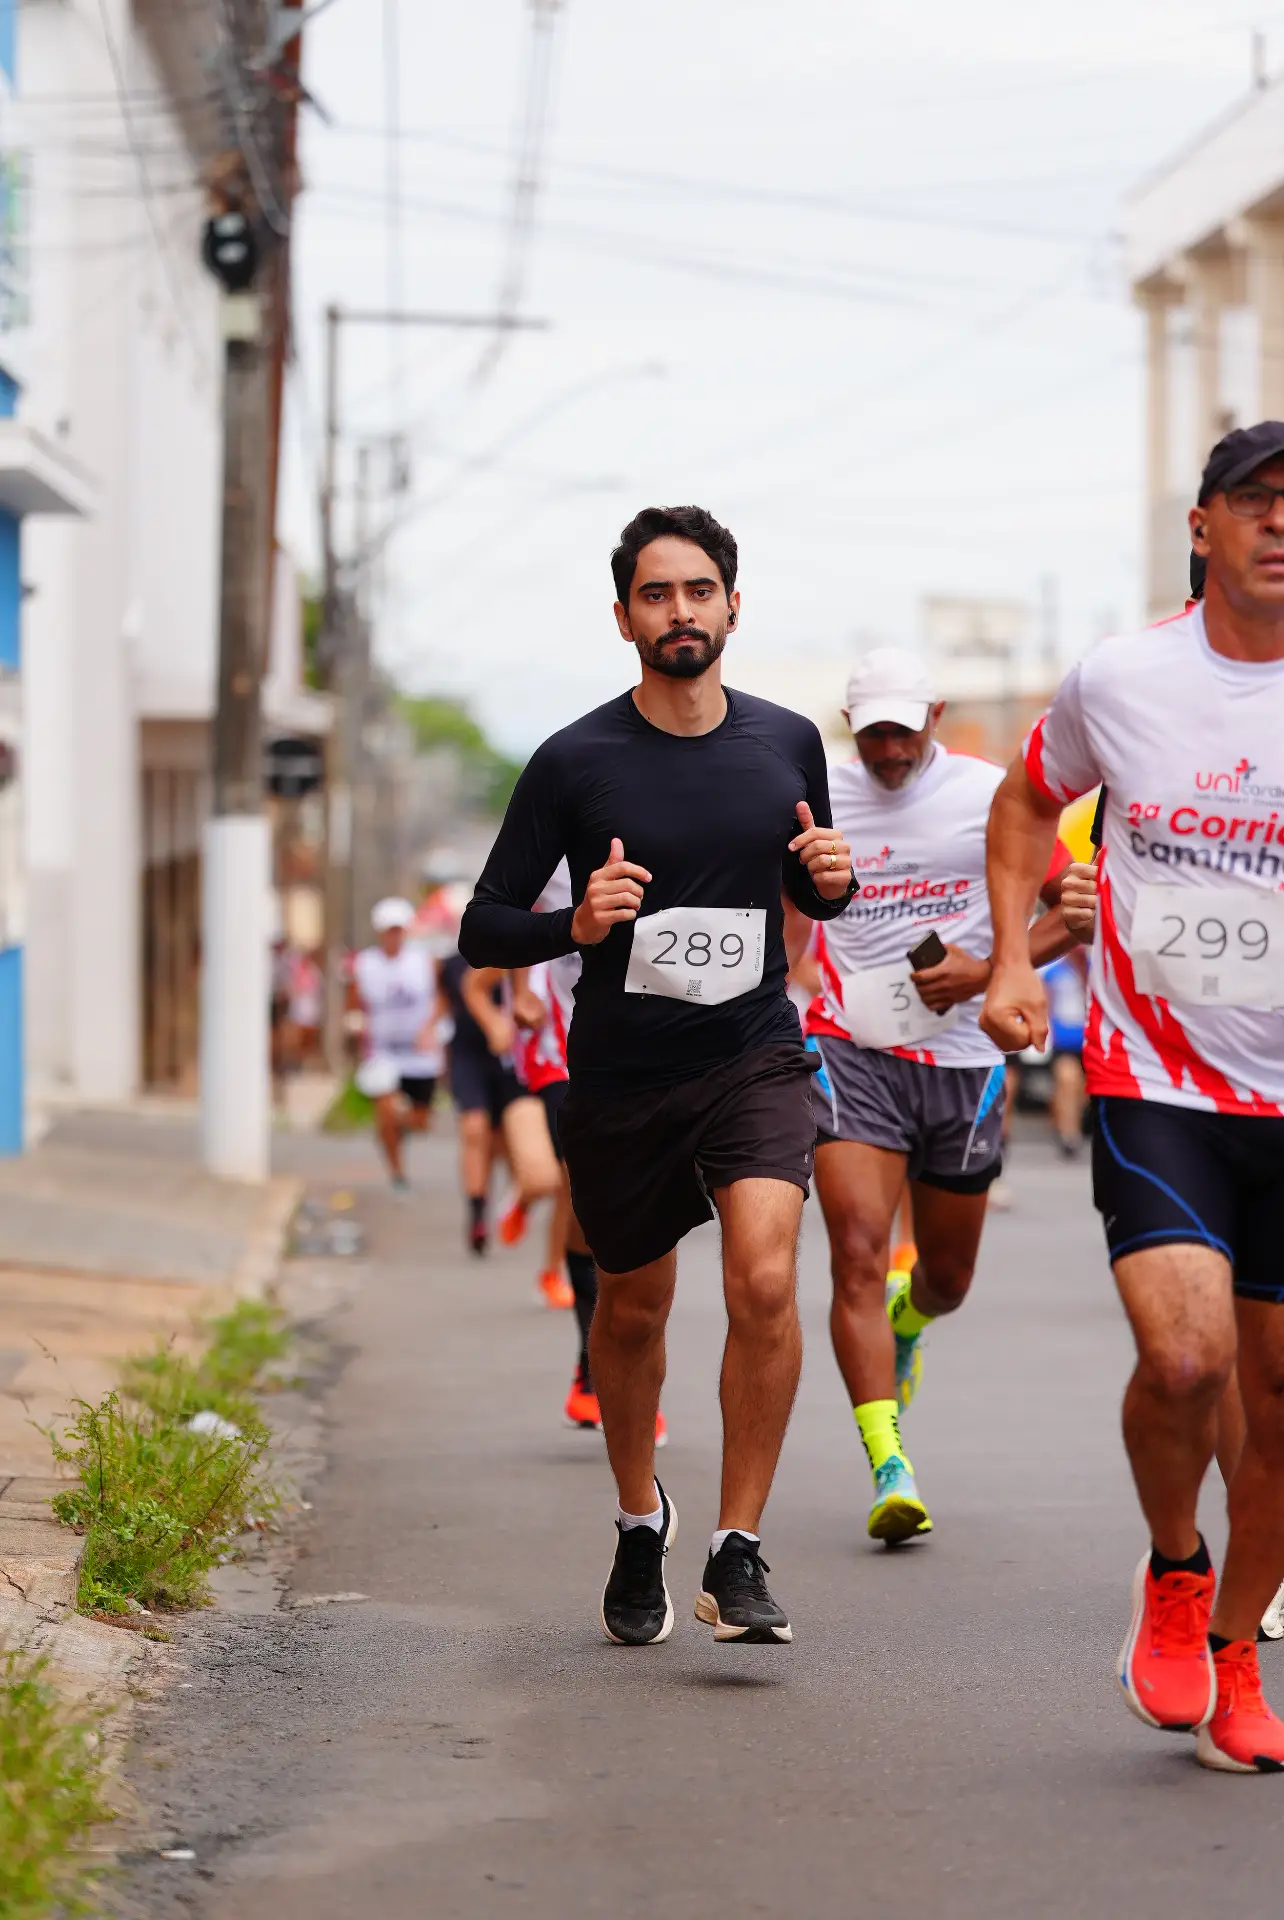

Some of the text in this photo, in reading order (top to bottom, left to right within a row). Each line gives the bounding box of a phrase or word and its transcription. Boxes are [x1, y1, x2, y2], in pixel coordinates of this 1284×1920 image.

[1130, 831, 1284, 876] Caminh
[954, 879, 969, 895] e
[651, 930, 744, 969] 289
[1157, 915, 1269, 961] 299
